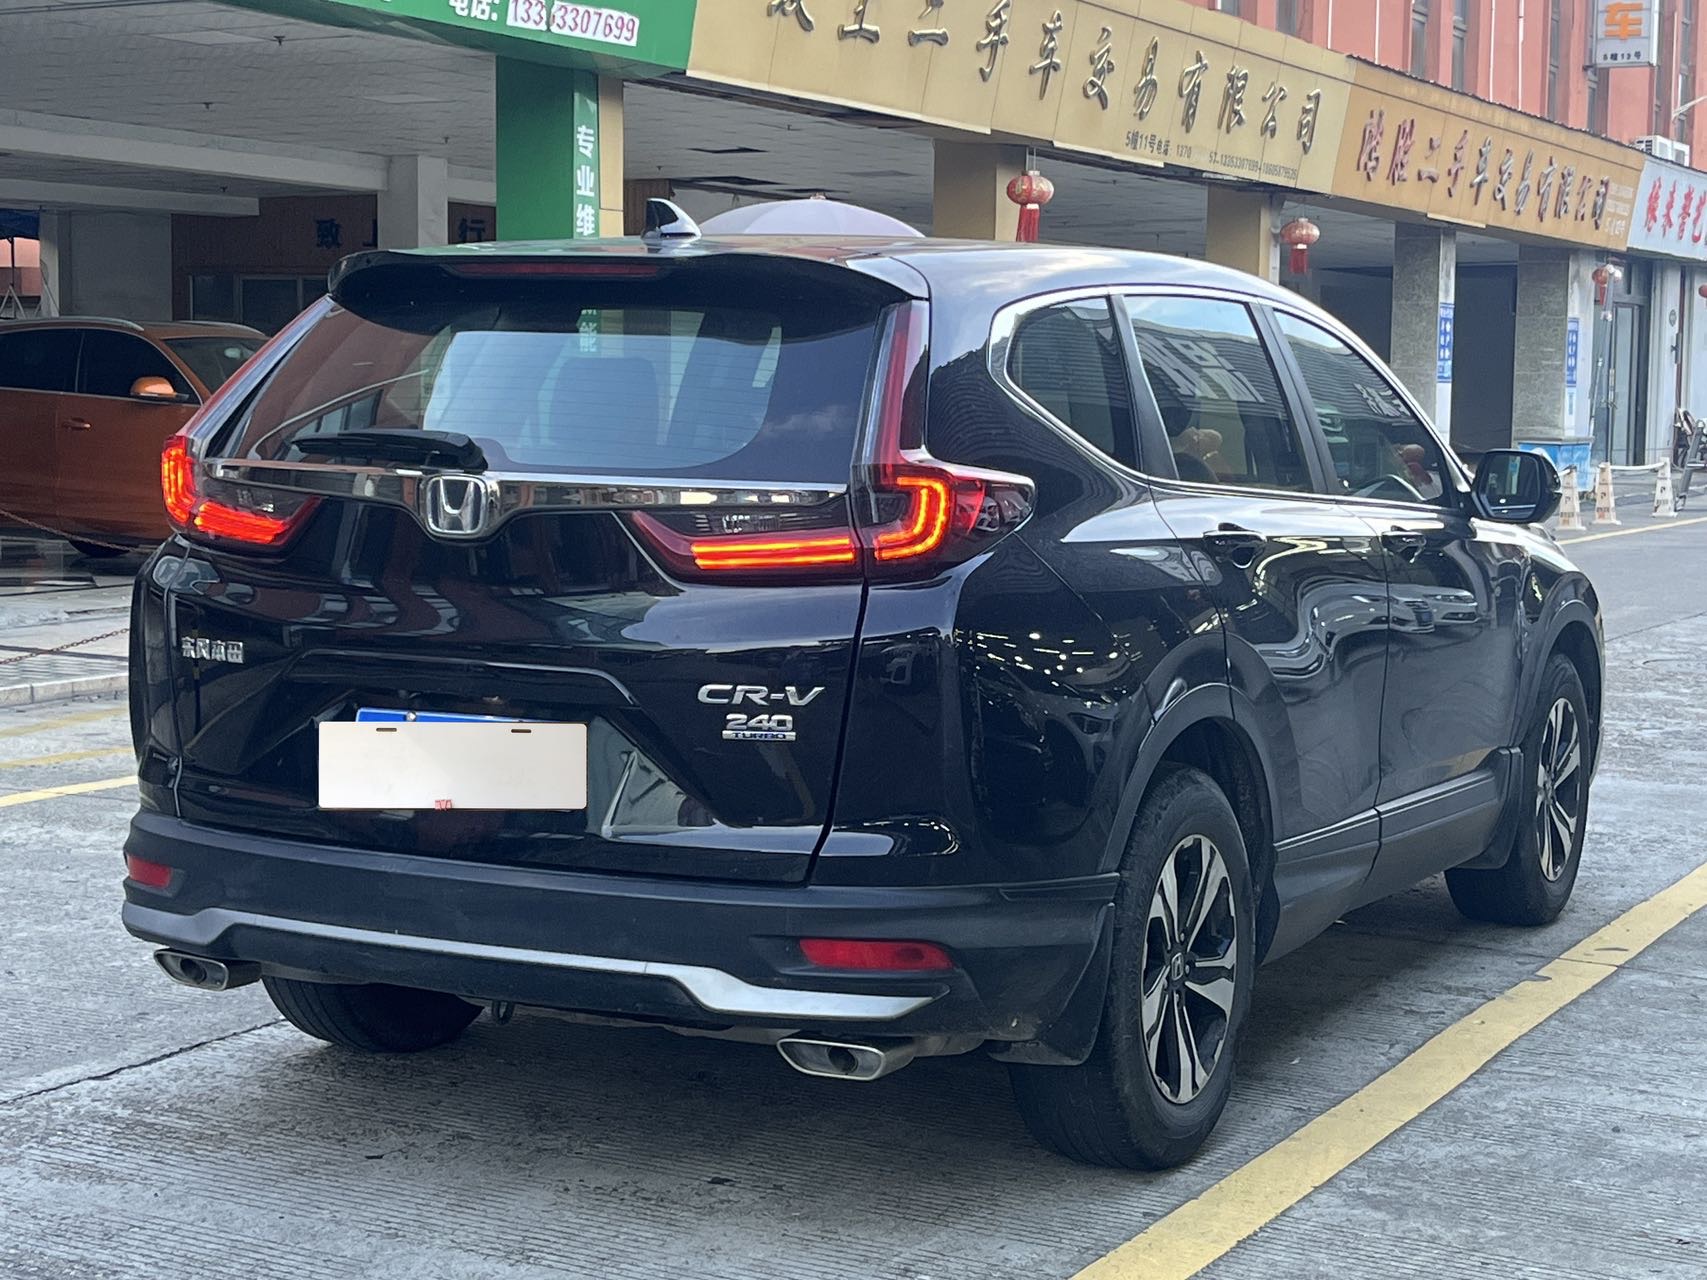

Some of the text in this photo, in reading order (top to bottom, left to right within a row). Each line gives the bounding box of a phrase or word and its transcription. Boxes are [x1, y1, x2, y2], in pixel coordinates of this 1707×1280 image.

[181, 636, 244, 664] 东风本田
[697, 683, 826, 706] CR-V
[725, 713, 793, 732] 240
[731, 731, 788, 741] TURBO
